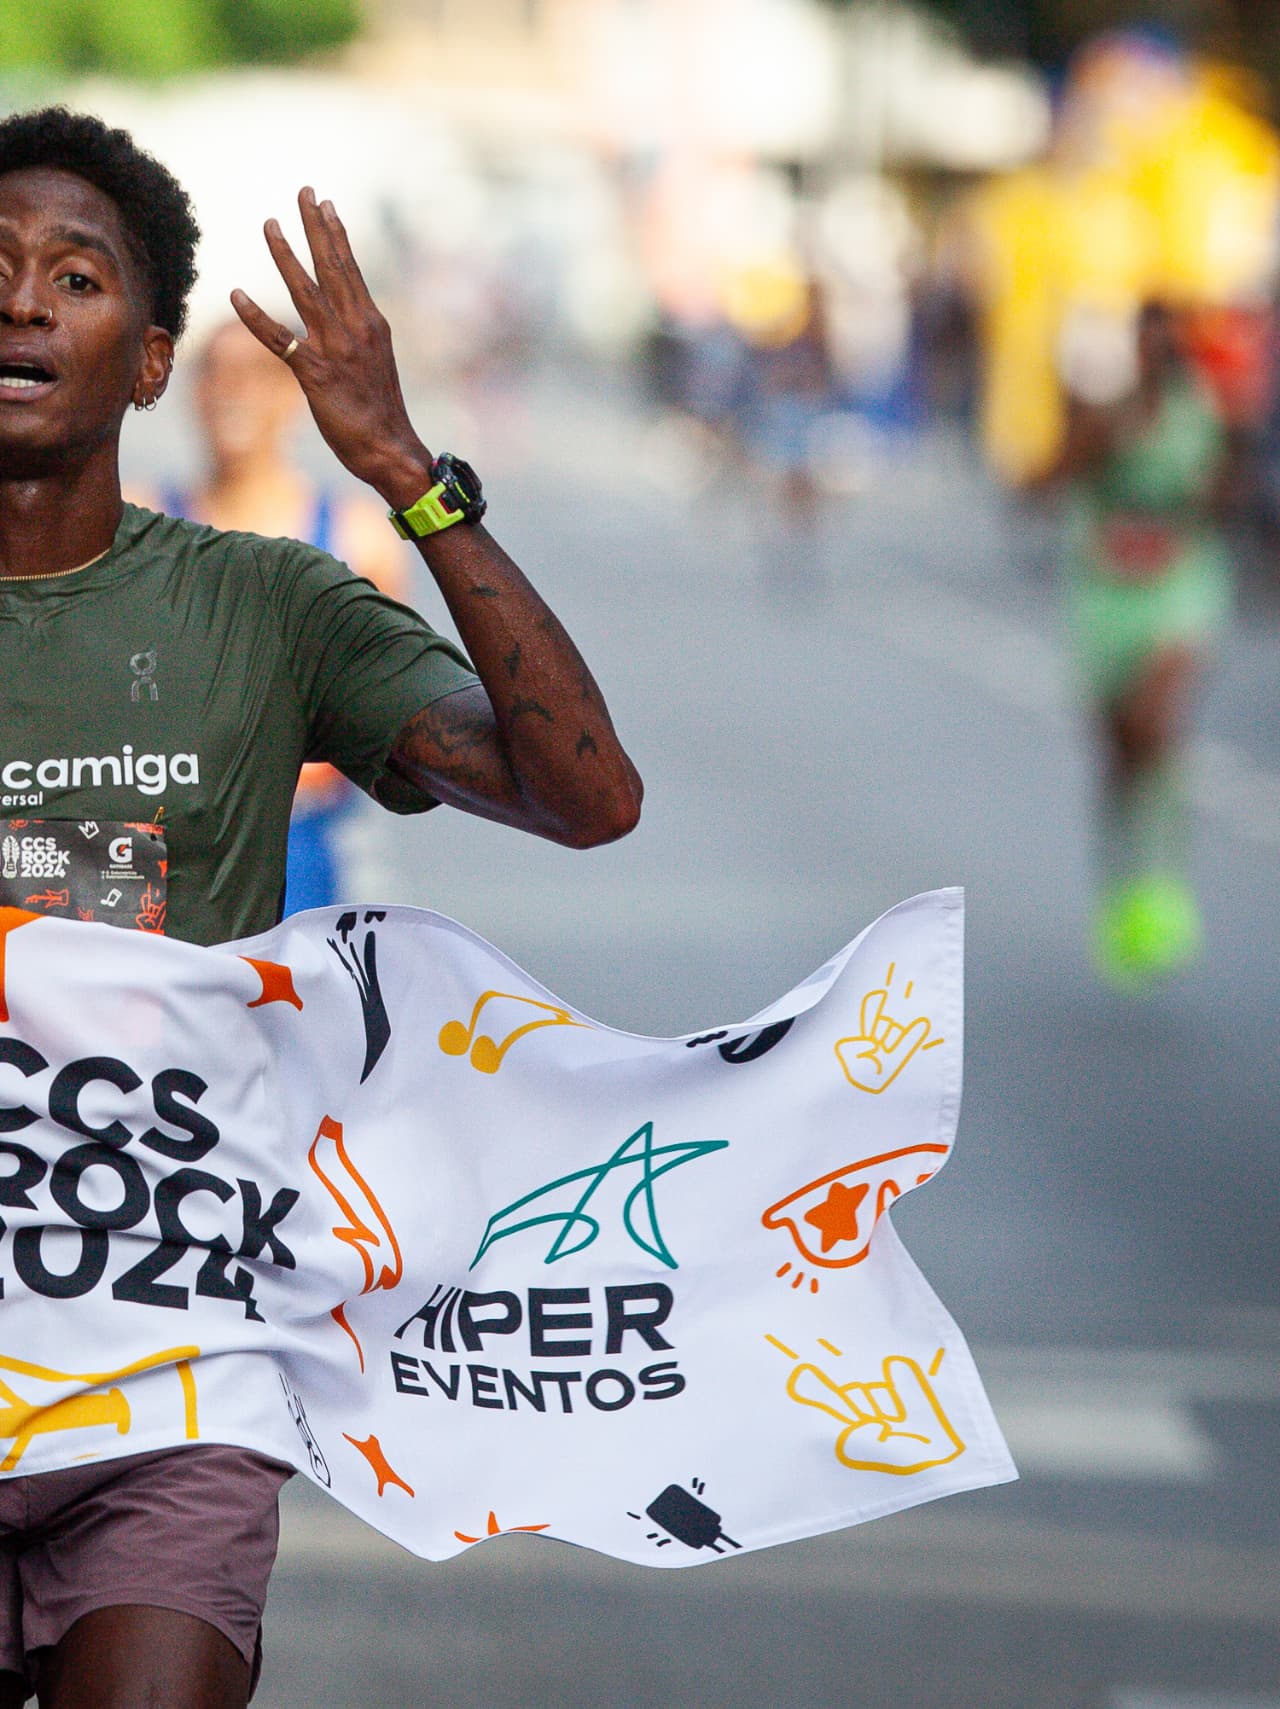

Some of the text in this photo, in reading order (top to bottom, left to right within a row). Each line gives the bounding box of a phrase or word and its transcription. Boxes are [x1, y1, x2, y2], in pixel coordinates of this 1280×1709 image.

[20, 837, 57, 851] CCS
[20, 850, 71, 865] ROCK
[20, 863, 66, 878] 2024
[393, 1282, 675, 1357] HIPER
[390, 1351, 686, 1413] EVENTOS
